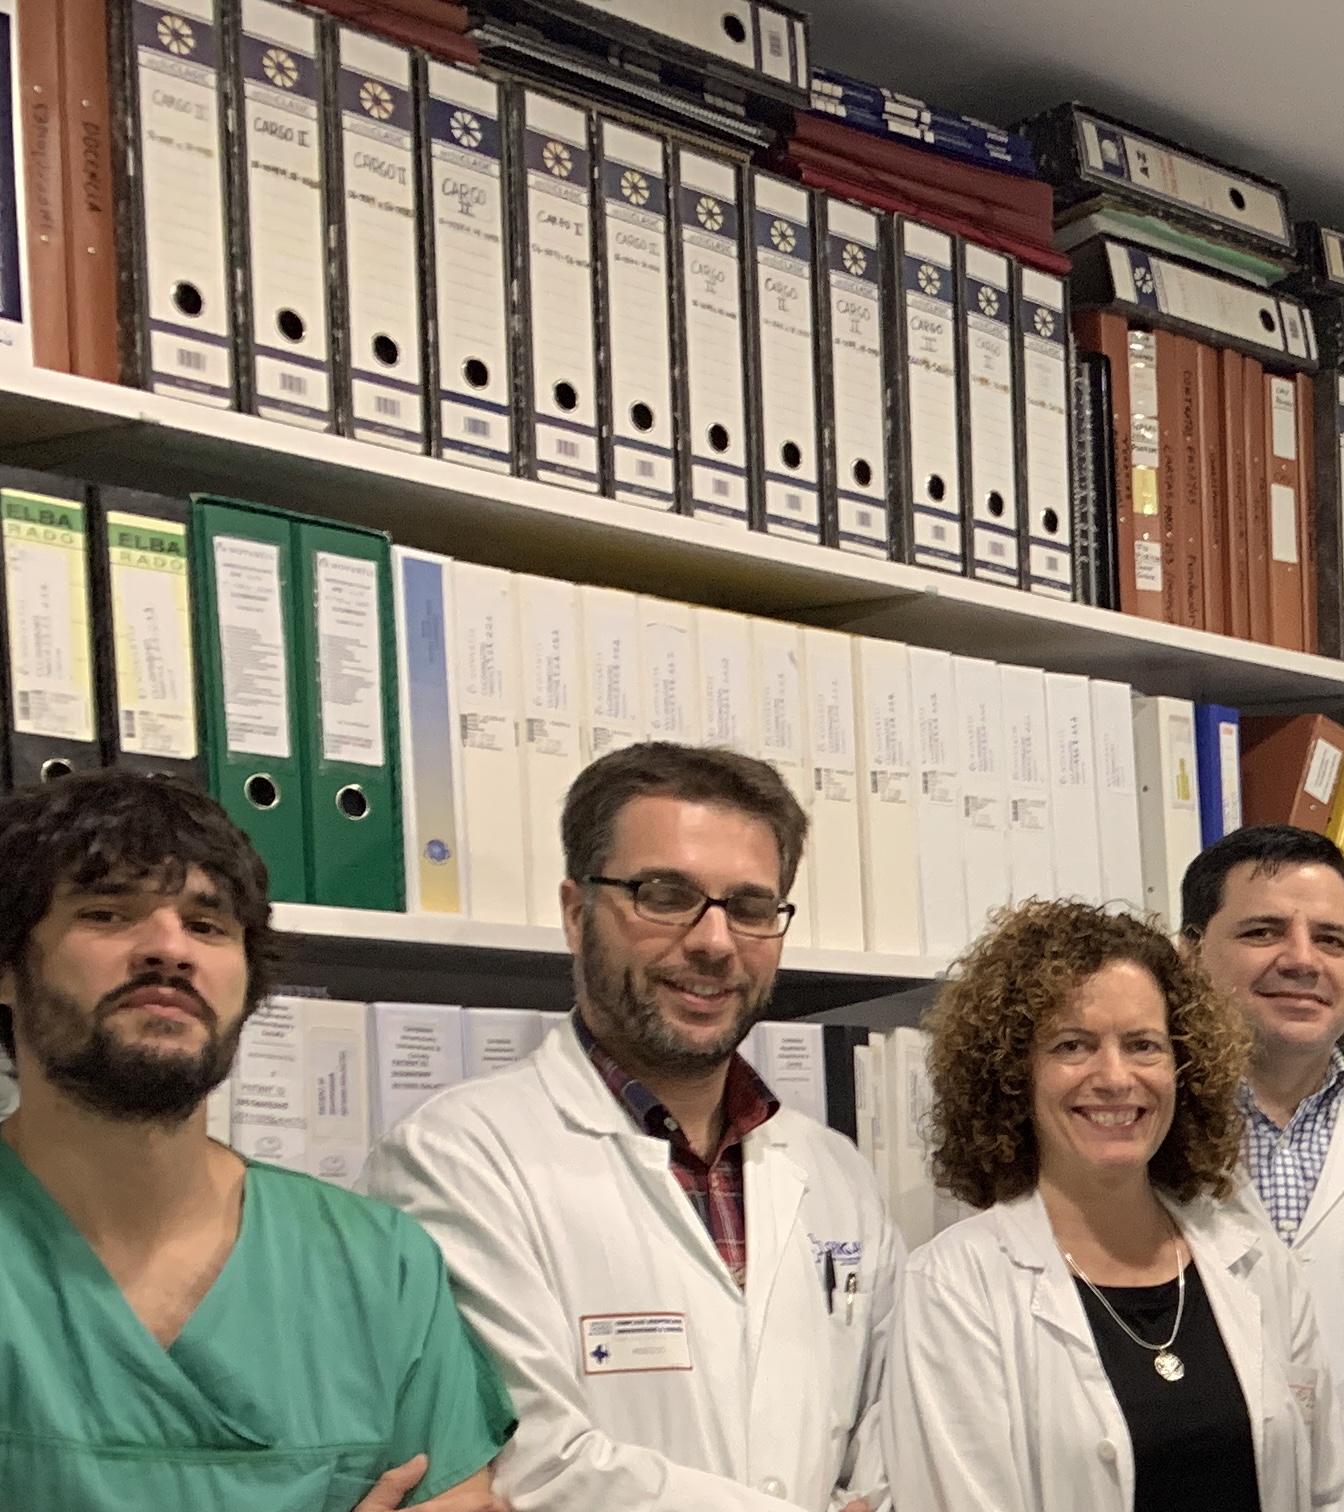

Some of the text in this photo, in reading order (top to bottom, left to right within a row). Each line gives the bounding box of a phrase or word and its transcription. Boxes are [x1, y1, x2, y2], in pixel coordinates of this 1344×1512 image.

[254, 117, 293, 141] CARGO
[353, 151, 396, 180] CARGO
[442, 177, 487, 206] CARGO
[836, 299, 871, 321] CARGO
[911, 316, 943, 334] CARGO
[7, 503, 73, 530] ELBA
[7, 524, 74, 545] RADO
[118, 532, 181, 555] ELBA
[119, 551, 184, 571] RADO
